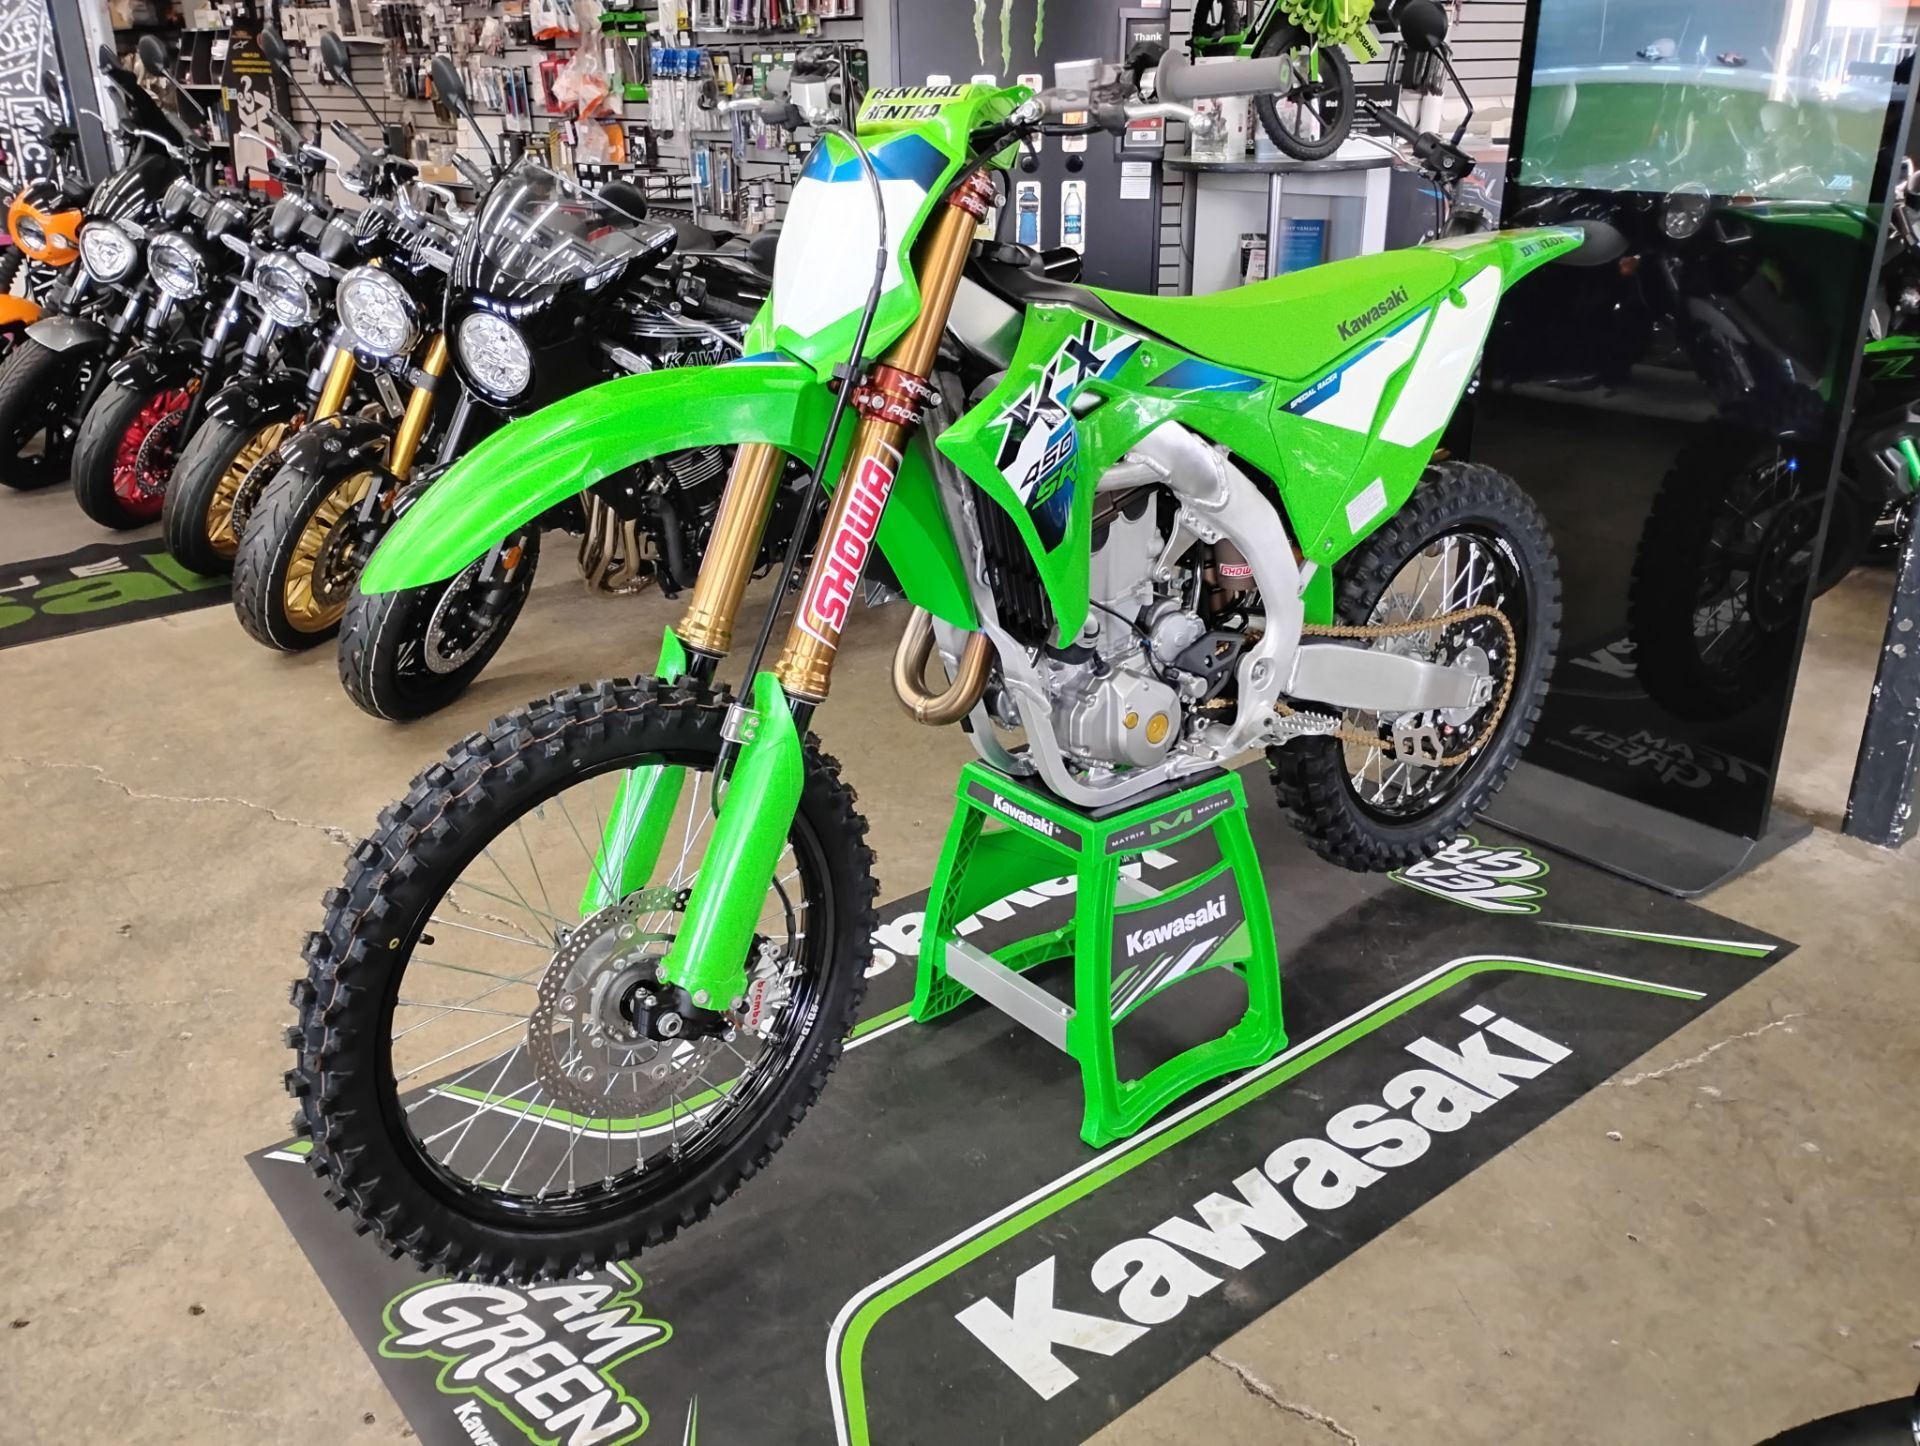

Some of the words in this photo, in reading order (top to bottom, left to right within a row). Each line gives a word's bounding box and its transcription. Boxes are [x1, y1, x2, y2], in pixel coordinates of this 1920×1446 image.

[1133, 32, 1162, 41] Thank
[867, 103, 943, 121] RENTHA
[1337, 284, 1409, 342] Kawasaki
[664, 347, 742, 370] KAWA
[1020, 430, 1075, 490] 450
[813, 456, 895, 634] SHOWA
[1222, 565, 1253, 576] SHOW
[993, 793, 1054, 836] Kawasaki
[1111, 831, 1145, 847] MATRIX
[1197, 799, 1229, 814] MATRIX
[1396, 860, 1537, 912] TEA
[1126, 895, 1227, 957] Kawasaki
[751, 980, 766, 1026] brembo
[955, 1004, 1573, 1401] Kawasaki
[528, 1268, 660, 1365] AM
[396, 1282, 637, 1446] GREEN
